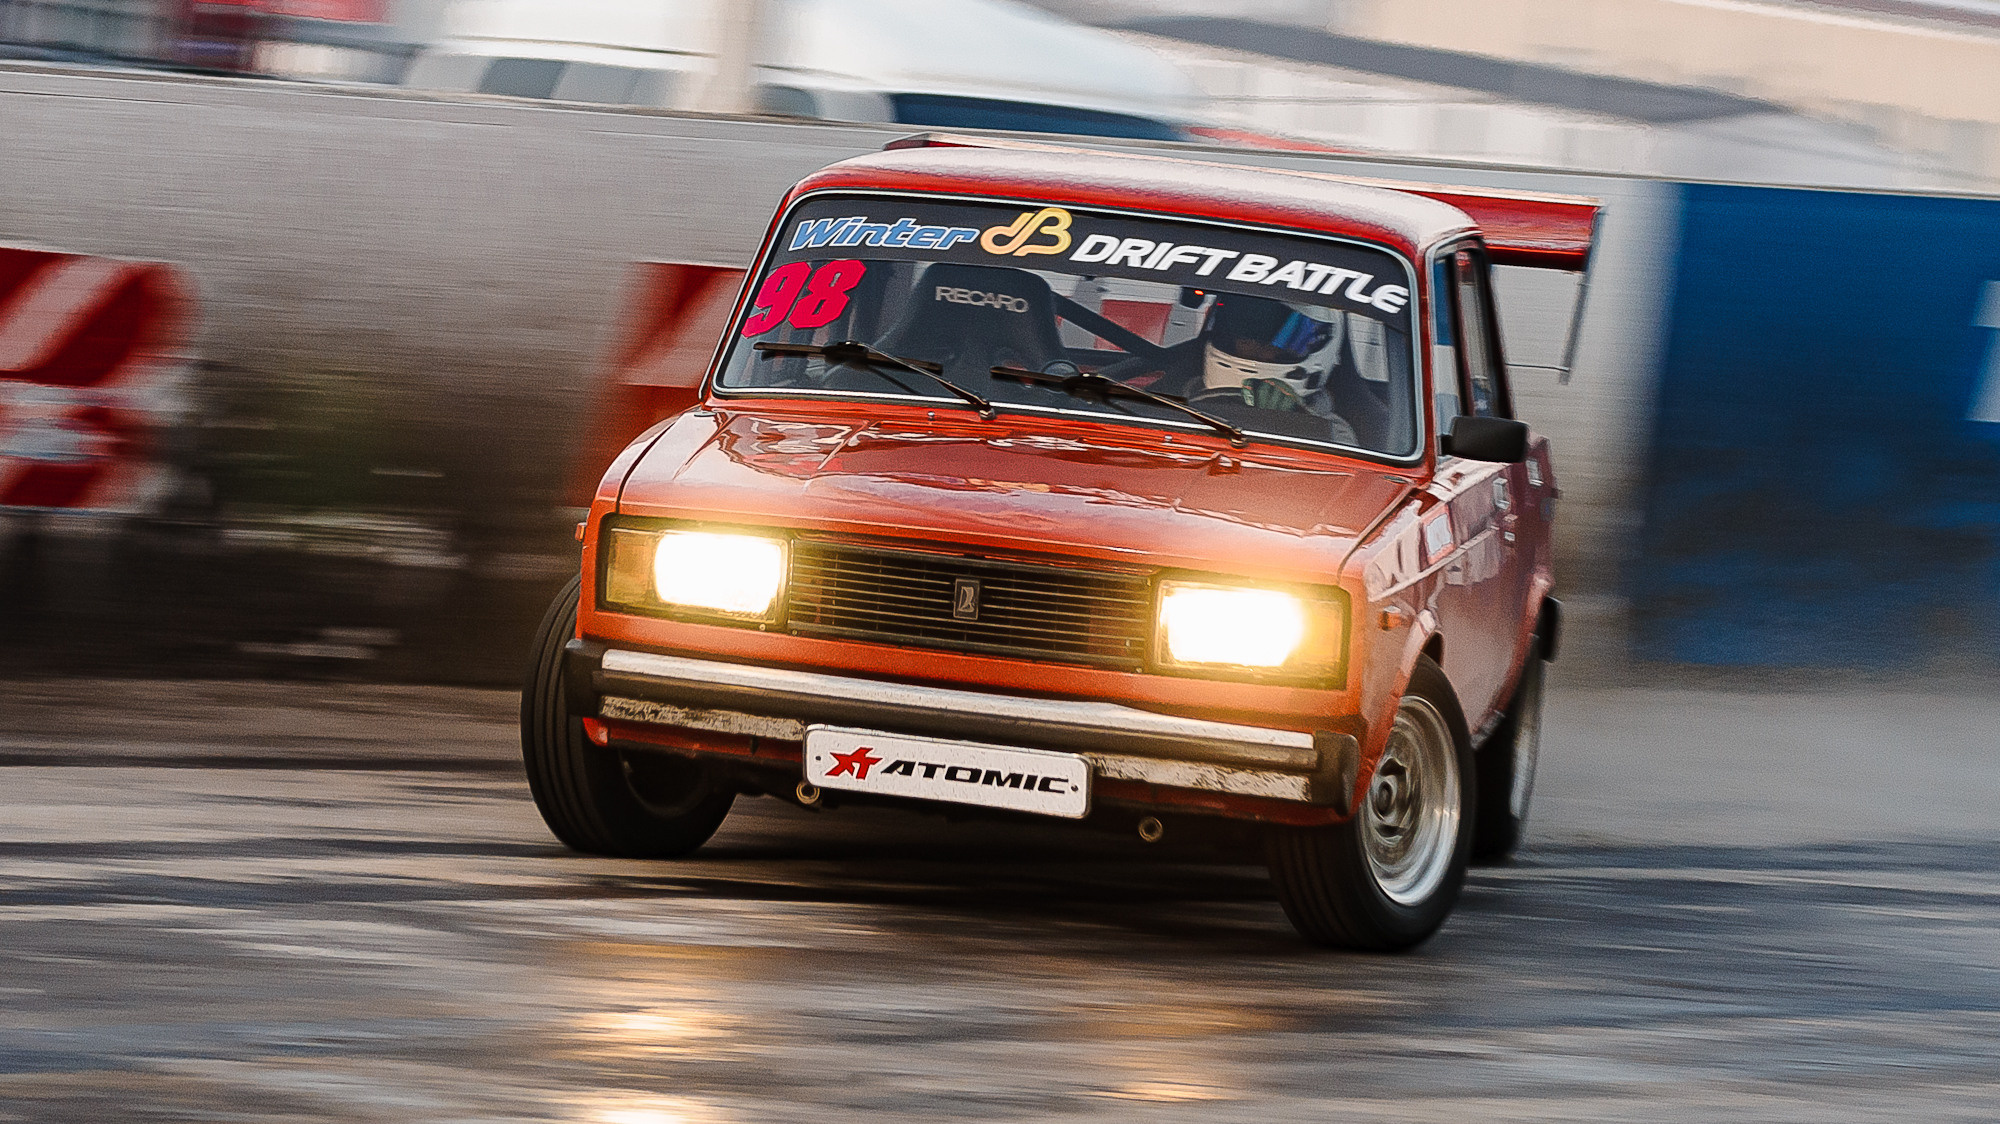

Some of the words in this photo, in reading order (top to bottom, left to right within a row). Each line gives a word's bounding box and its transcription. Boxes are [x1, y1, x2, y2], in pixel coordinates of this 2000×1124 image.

[788, 216, 980, 251] Winter
[1069, 234, 1240, 276] DRIFT
[1226, 253, 1409, 314] BATTLE
[741, 259, 867, 339] 98
[935, 286, 1029, 313] RECARO
[880, 758, 1069, 794] ATOMIC
